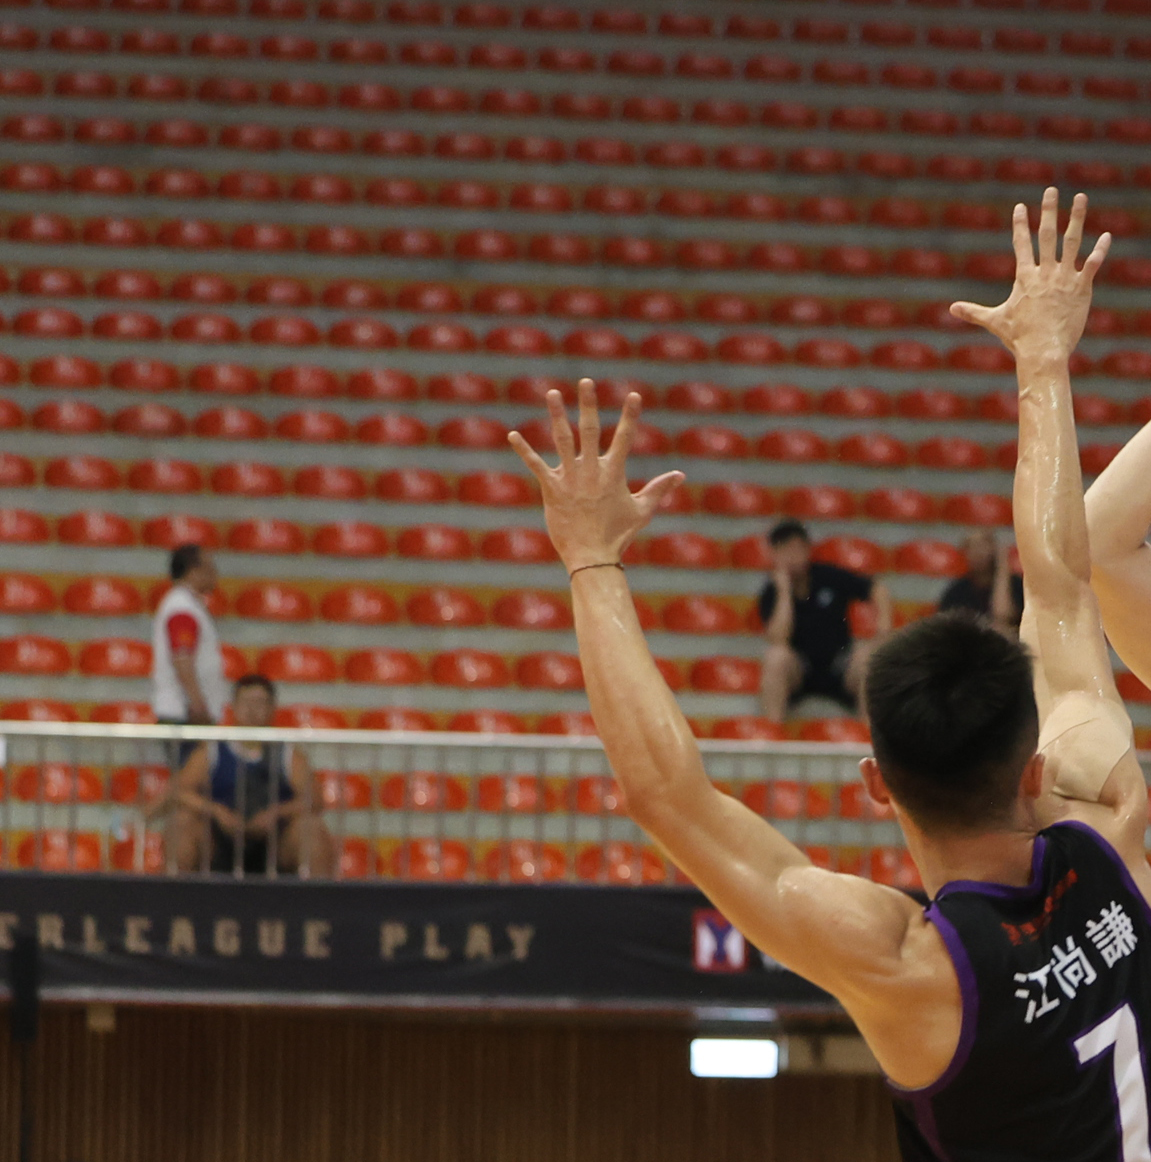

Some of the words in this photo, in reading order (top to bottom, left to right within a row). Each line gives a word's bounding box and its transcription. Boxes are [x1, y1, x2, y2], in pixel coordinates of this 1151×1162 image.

[380, 919, 534, 961] PLAY
[1013, 900, 1138, 1024] 江尚謙
